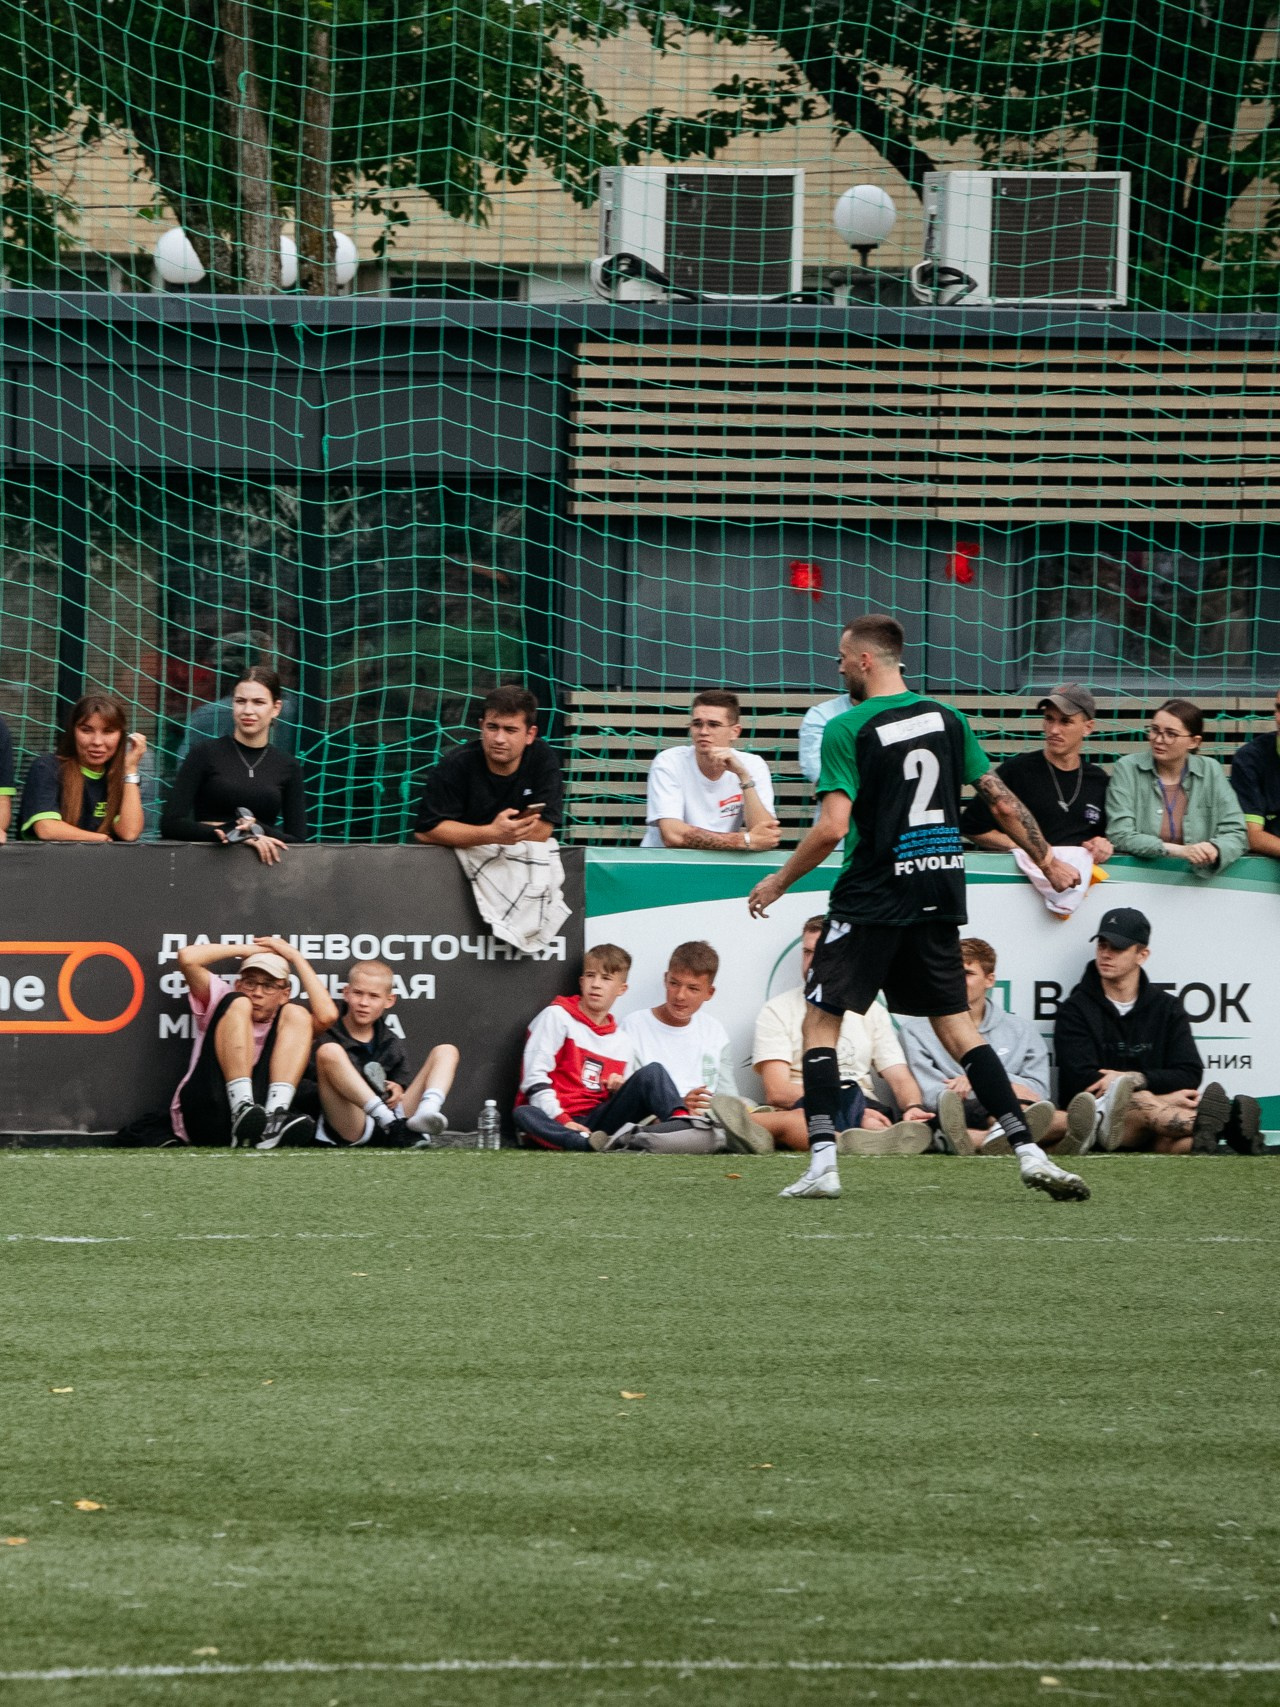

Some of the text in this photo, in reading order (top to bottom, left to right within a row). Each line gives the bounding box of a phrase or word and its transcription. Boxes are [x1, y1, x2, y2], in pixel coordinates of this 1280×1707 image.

[903, 748, 946, 828] 2
[894, 855, 965, 876] FC VOLAT
